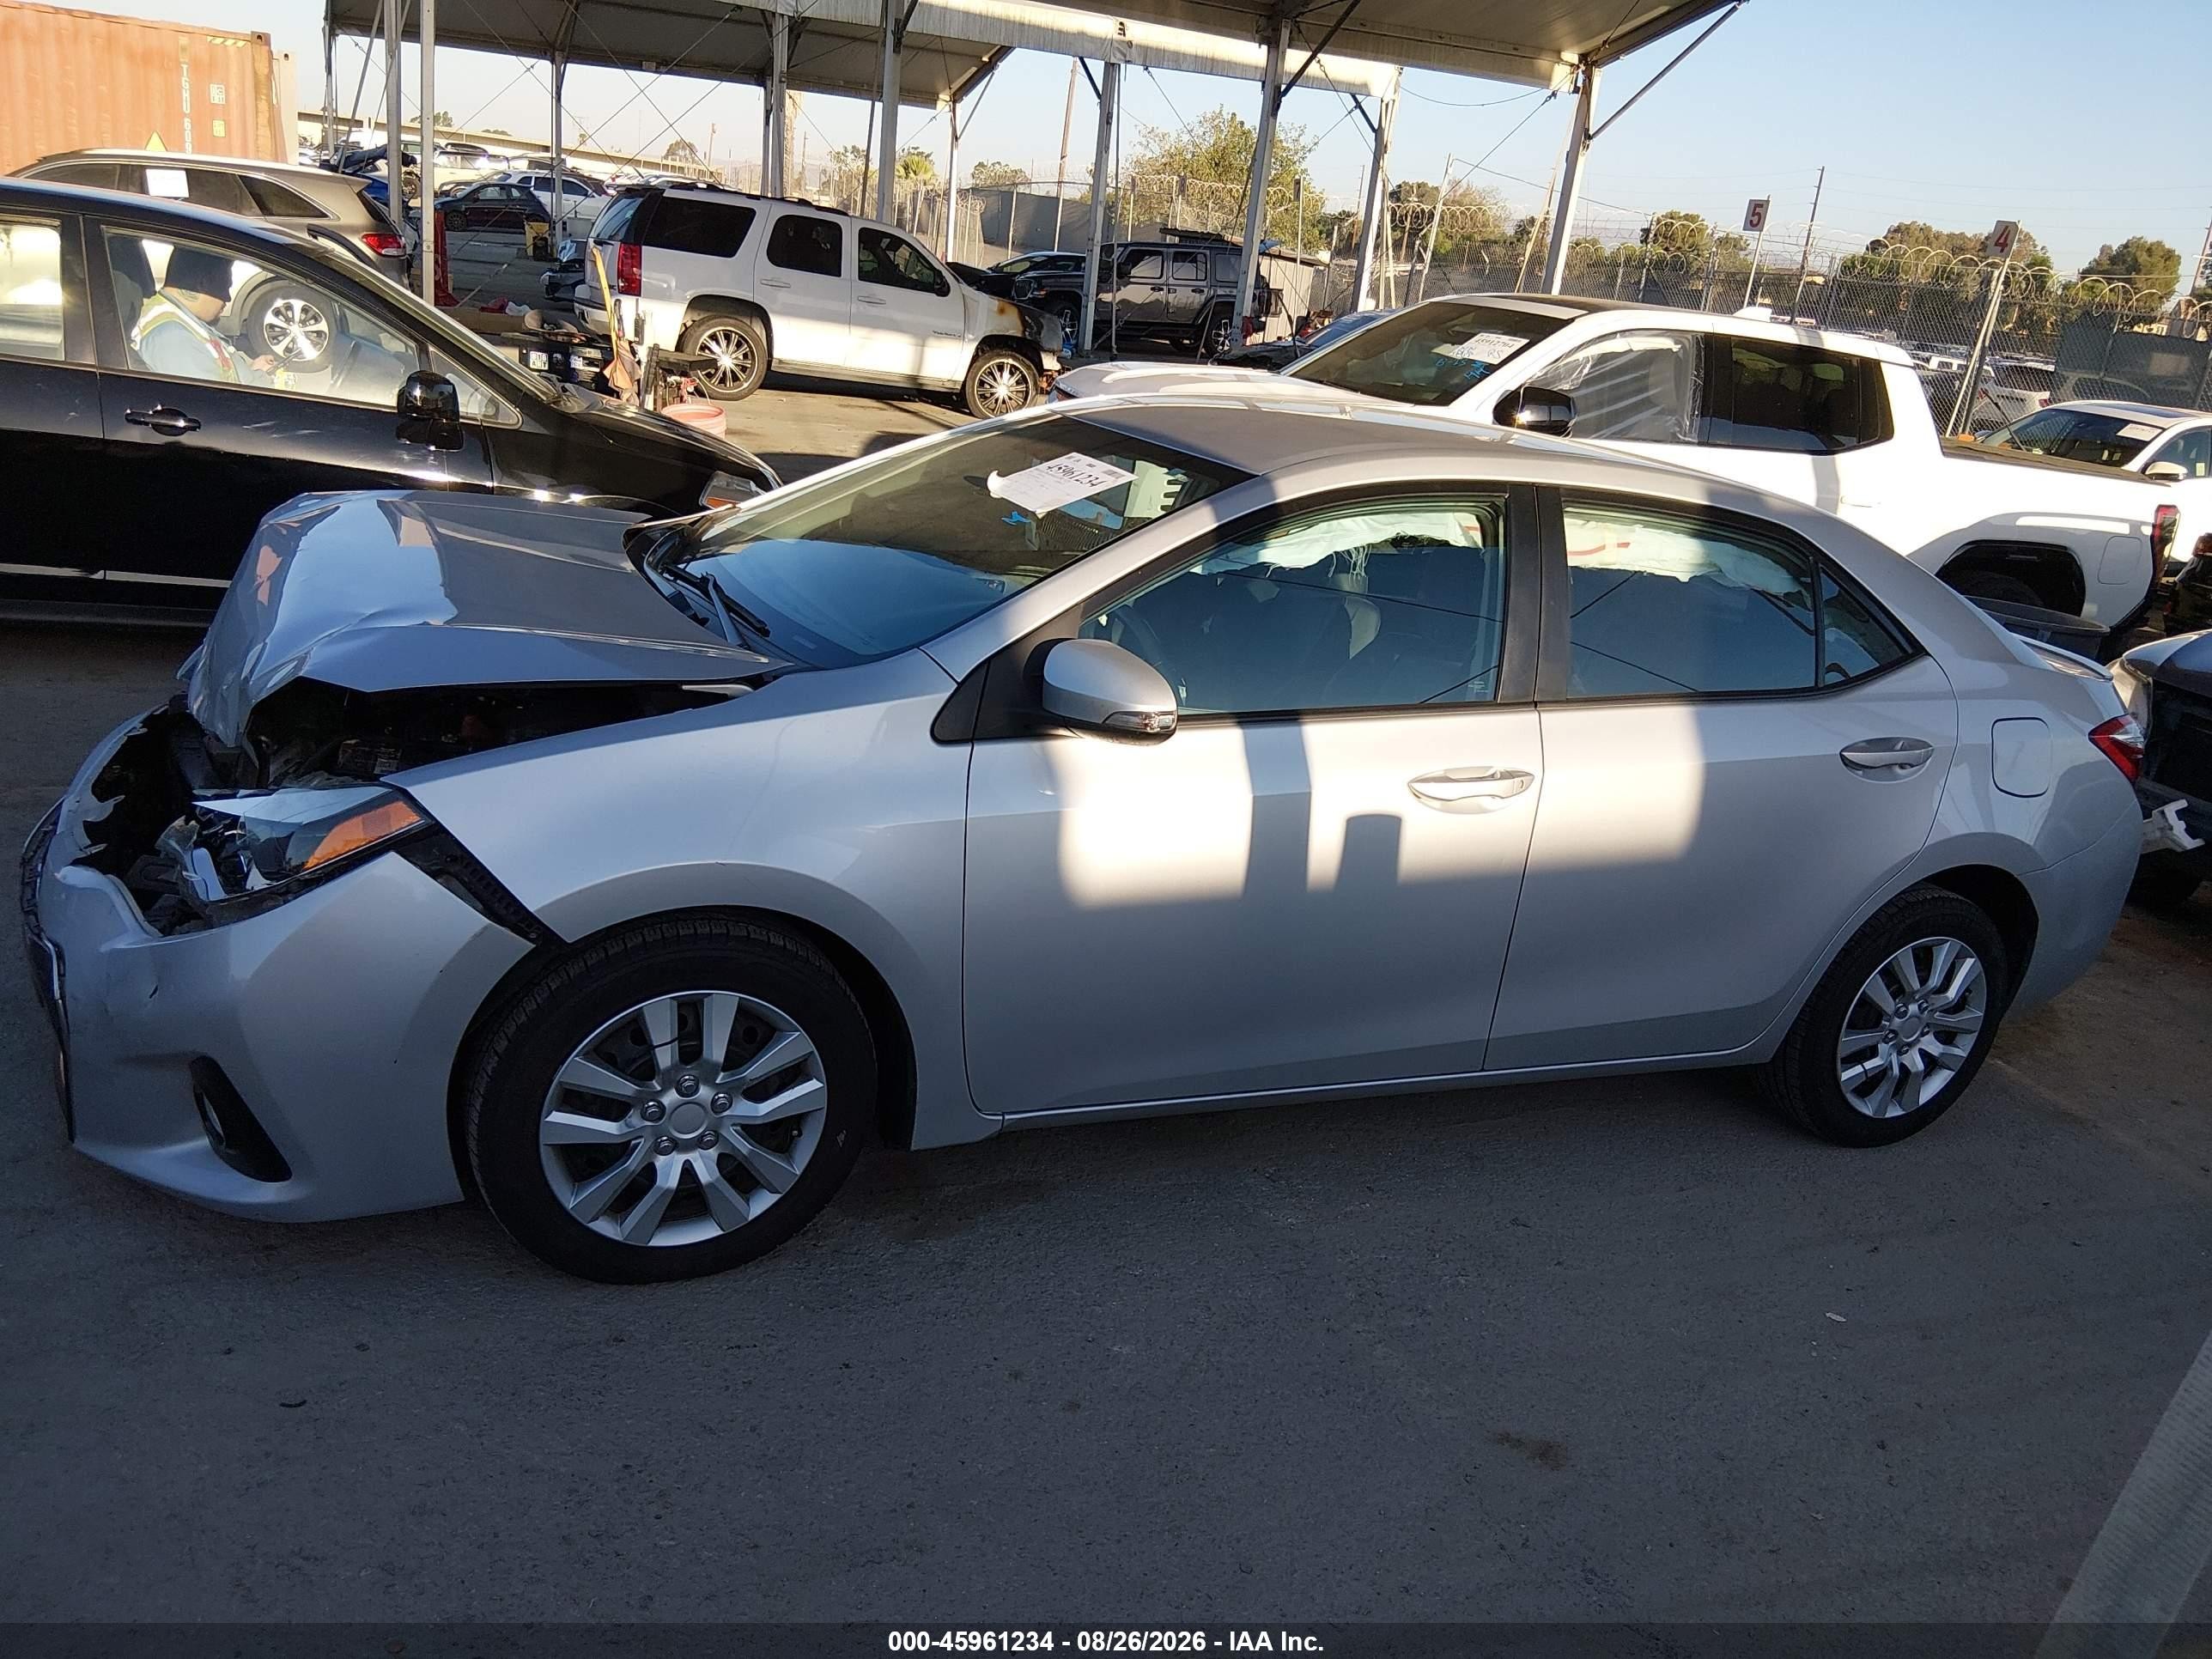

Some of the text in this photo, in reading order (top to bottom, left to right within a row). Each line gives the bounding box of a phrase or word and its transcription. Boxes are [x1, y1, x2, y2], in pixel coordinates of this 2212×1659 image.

[1748, 203, 1764, 228] 5
[1994, 225, 2011, 253] 4
[1045, 462, 1109, 489] 45961234
